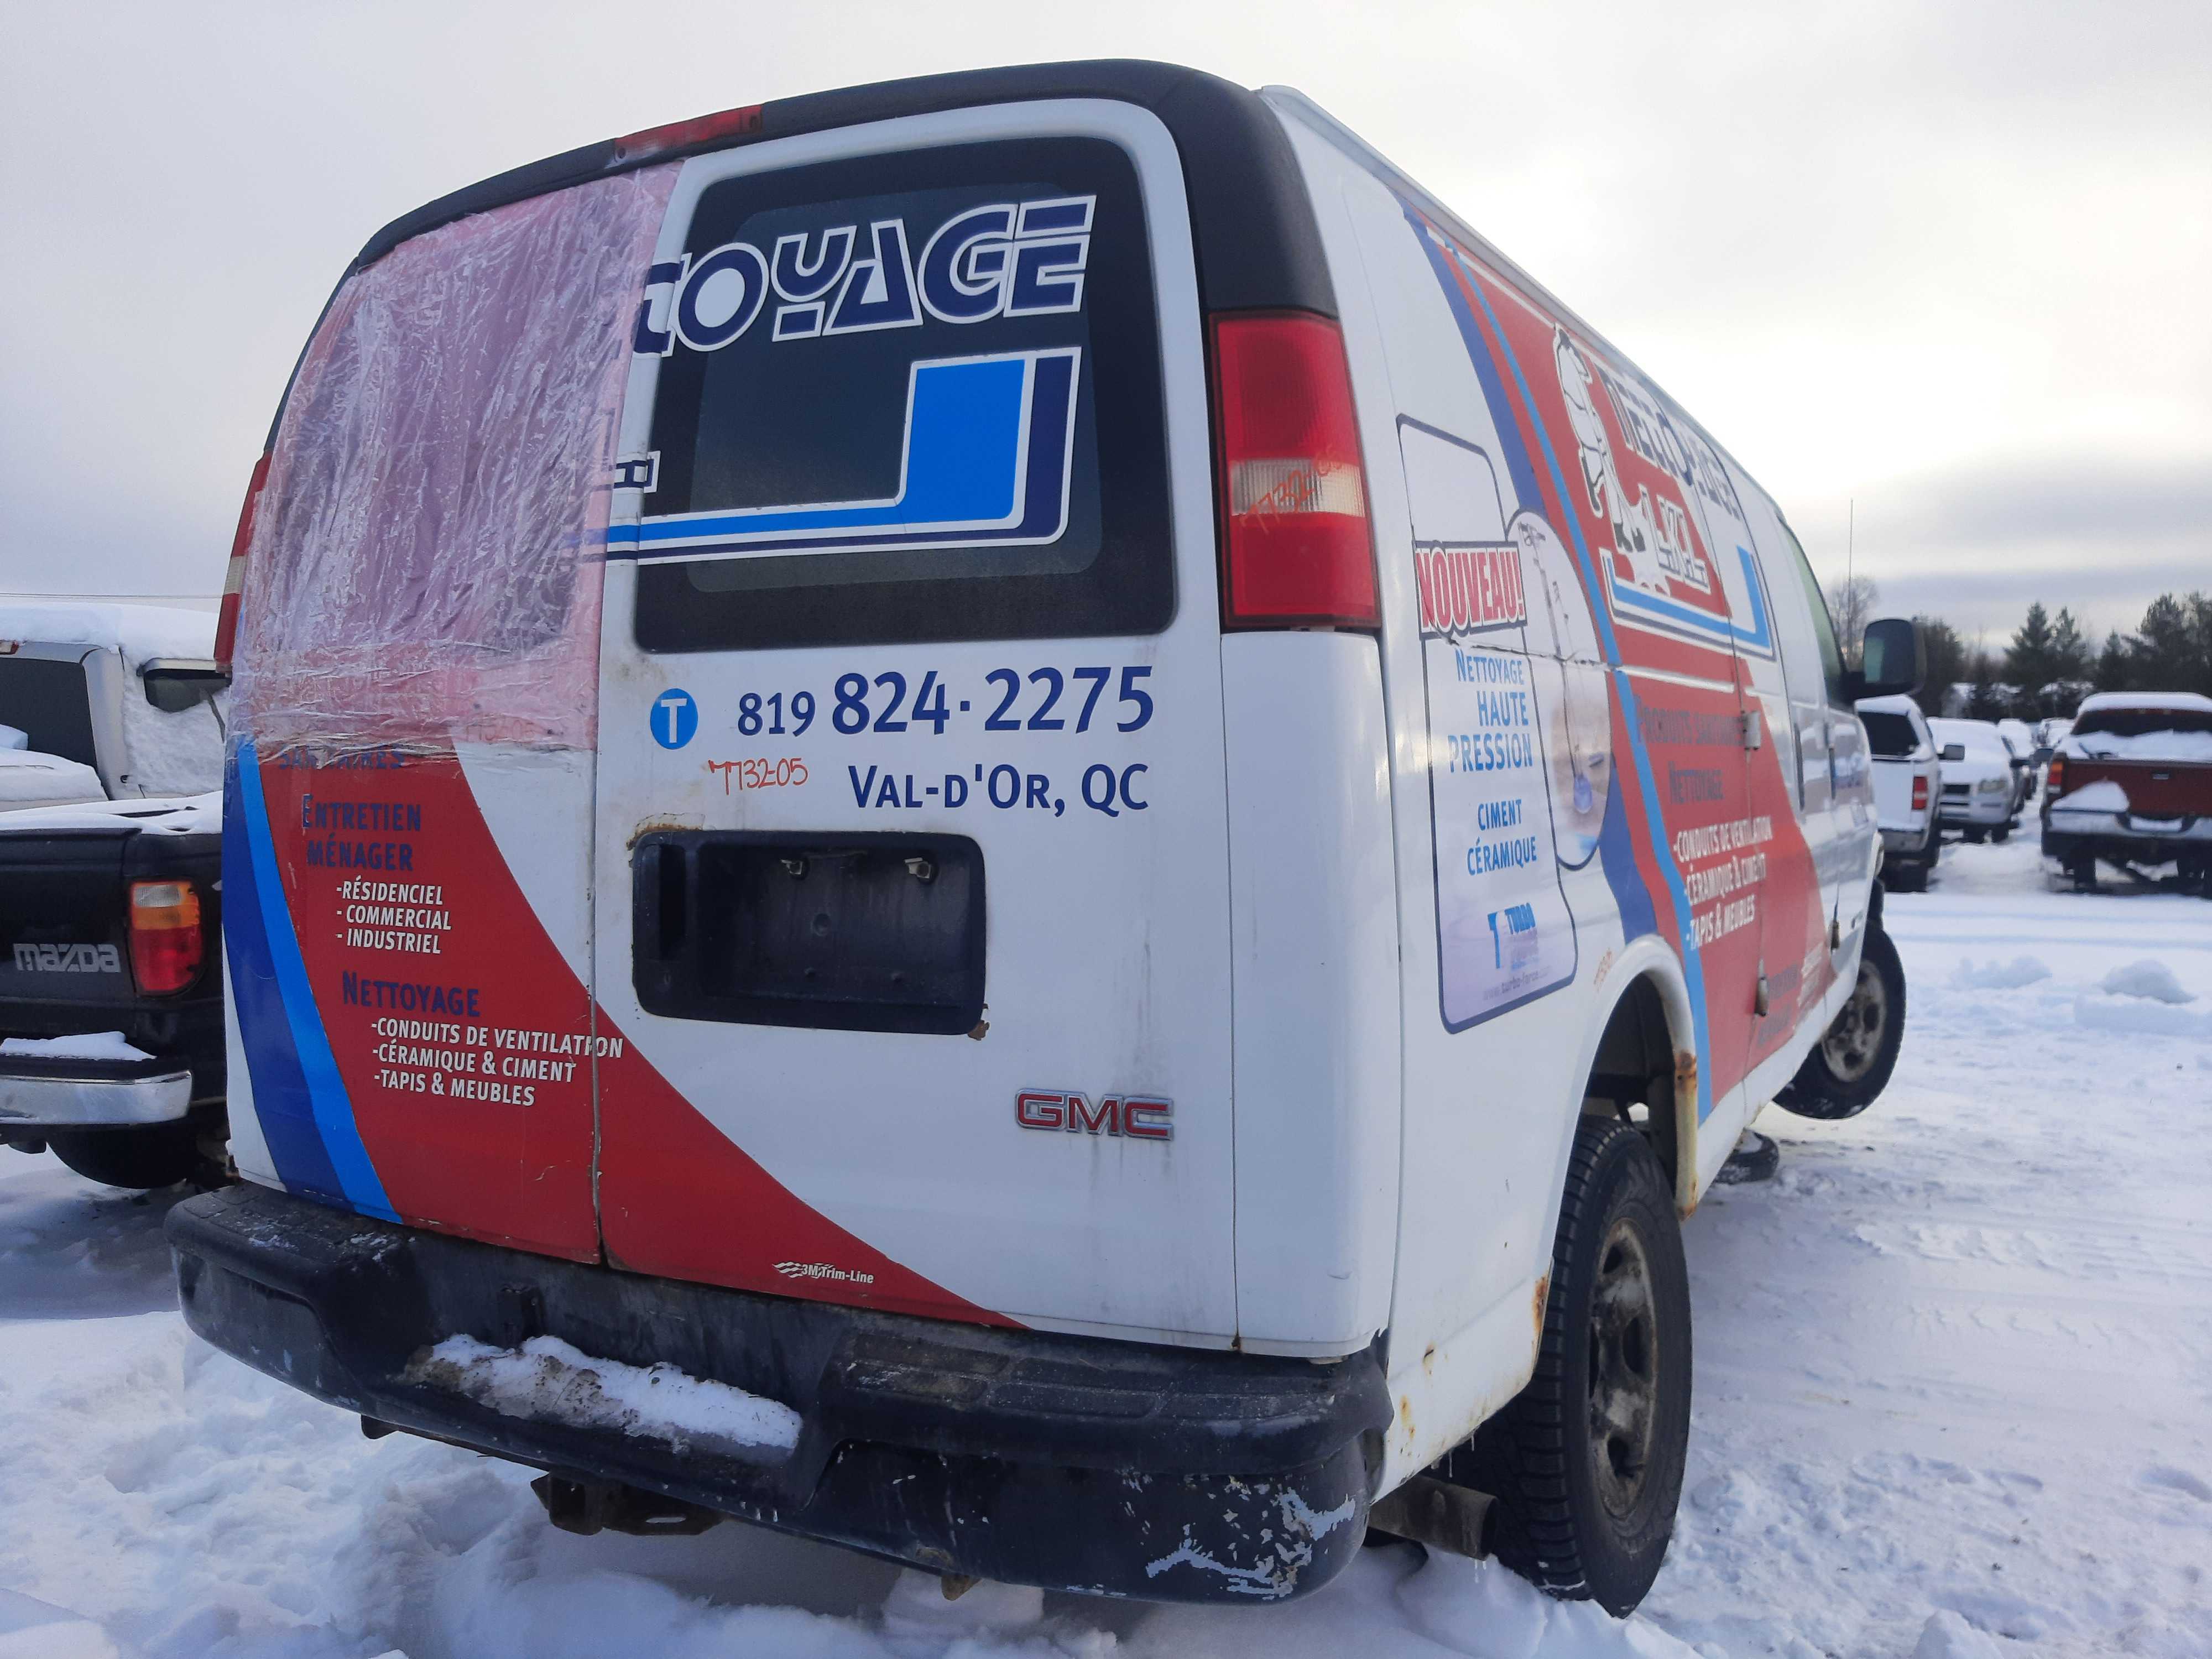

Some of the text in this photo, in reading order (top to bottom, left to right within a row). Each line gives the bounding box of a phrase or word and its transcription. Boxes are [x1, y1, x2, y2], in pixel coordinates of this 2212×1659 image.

[1415, 546, 1526, 634] NOUVEAU!
[1455, 649, 1525, 685] NETTOYAGE
[738, 692, 816, 737] 819
[1477, 691, 1529, 727] HAUTE
[1447, 733, 1533, 773] PRESSION
[1081, 763, 1150, 817] QC
[302, 794, 421, 831] ENTRETIEN
[1478, 799, 1522, 831] CIMENT
[306, 832, 413, 872] MÉNAGER
[1467, 837, 1537, 875] CÉRAMIQUE
[346, 904, 452, 930] COMMERCIAL
[347, 928, 441, 954] INDUSTRIEL
[342, 970, 480, 1017] NETTOYAGE
[466, 1026, 489, 1047] DE
[494, 1028, 623, 1058] VENTILATION
[482, 1051, 497, 1074] &
[502, 1057, 576, 1083] CIMENT
[431, 1072, 445, 1095] &
[450, 1078, 535, 1107] MEUBLES
[1016, 1088, 1173, 1141] GMC
